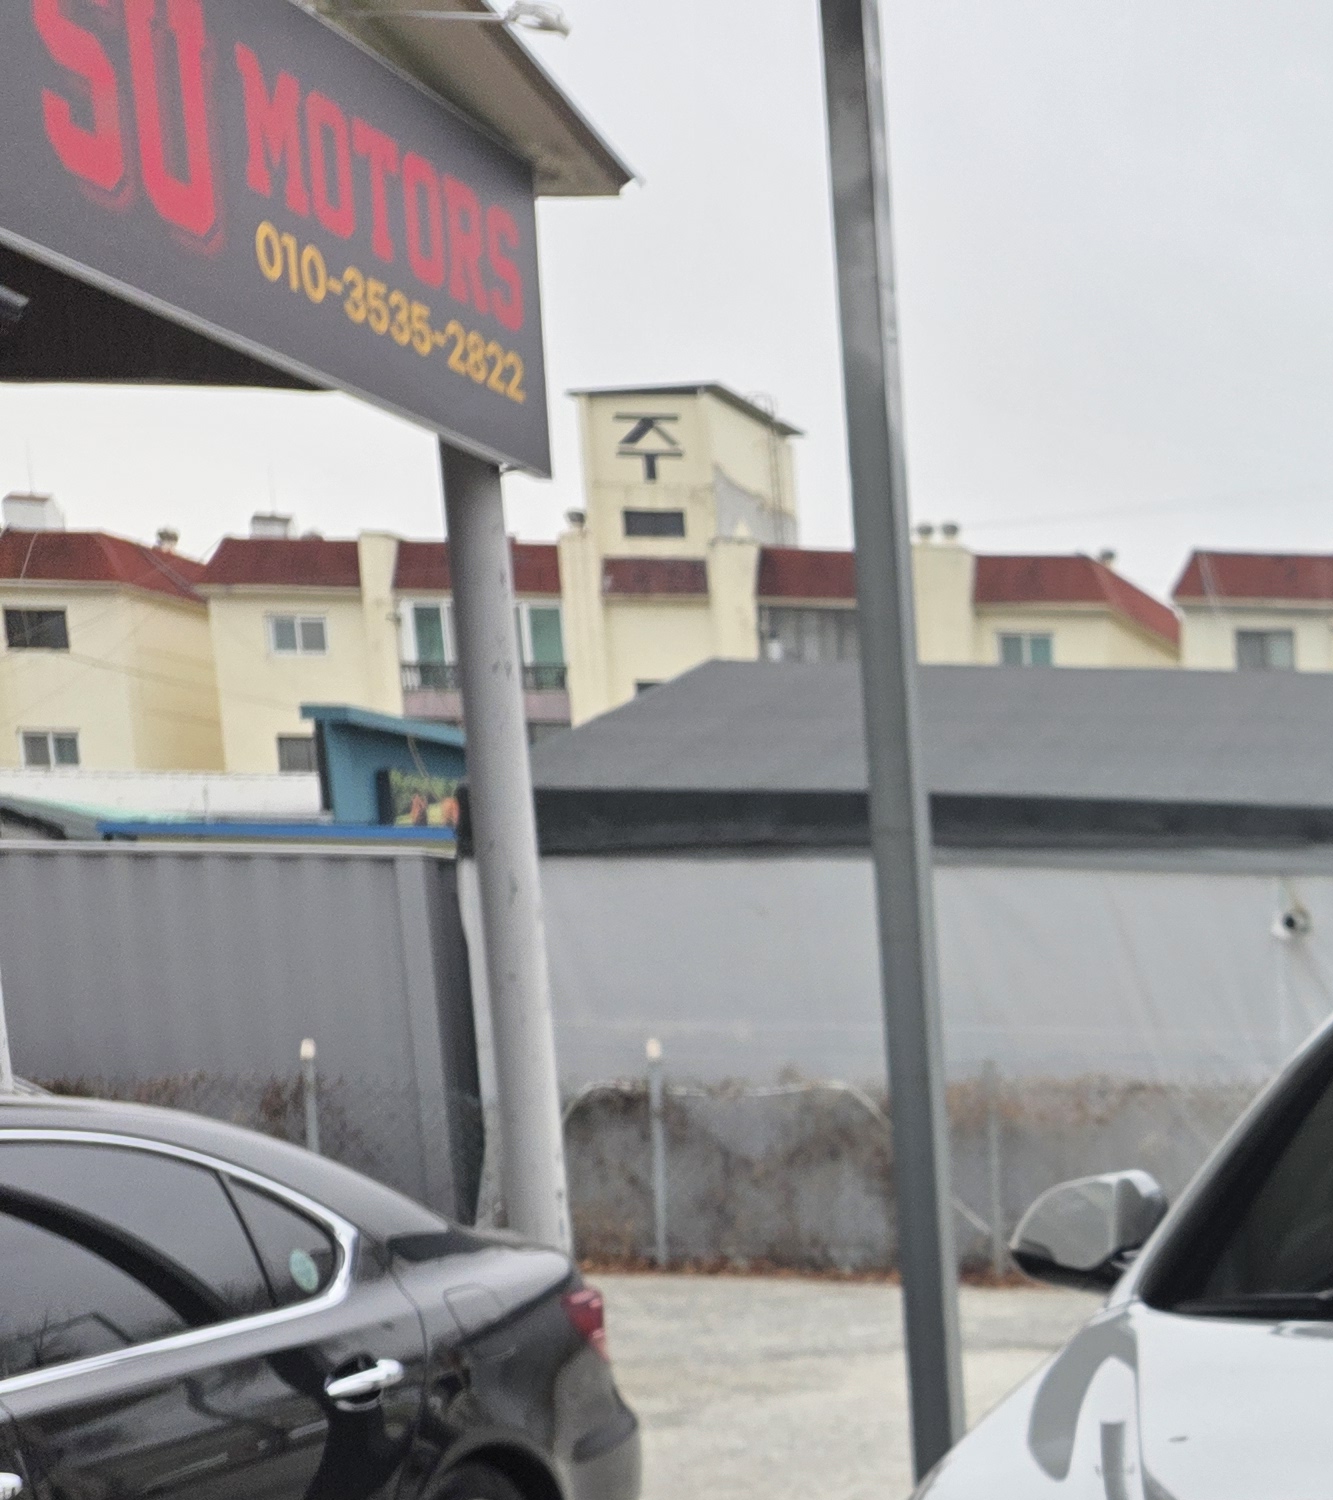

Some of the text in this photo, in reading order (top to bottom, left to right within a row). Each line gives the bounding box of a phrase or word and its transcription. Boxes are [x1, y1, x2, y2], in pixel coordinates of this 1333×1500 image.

[32, 0, 525, 333] SU MOTORS
[255, 219, 527, 404] 010-3535-2822
